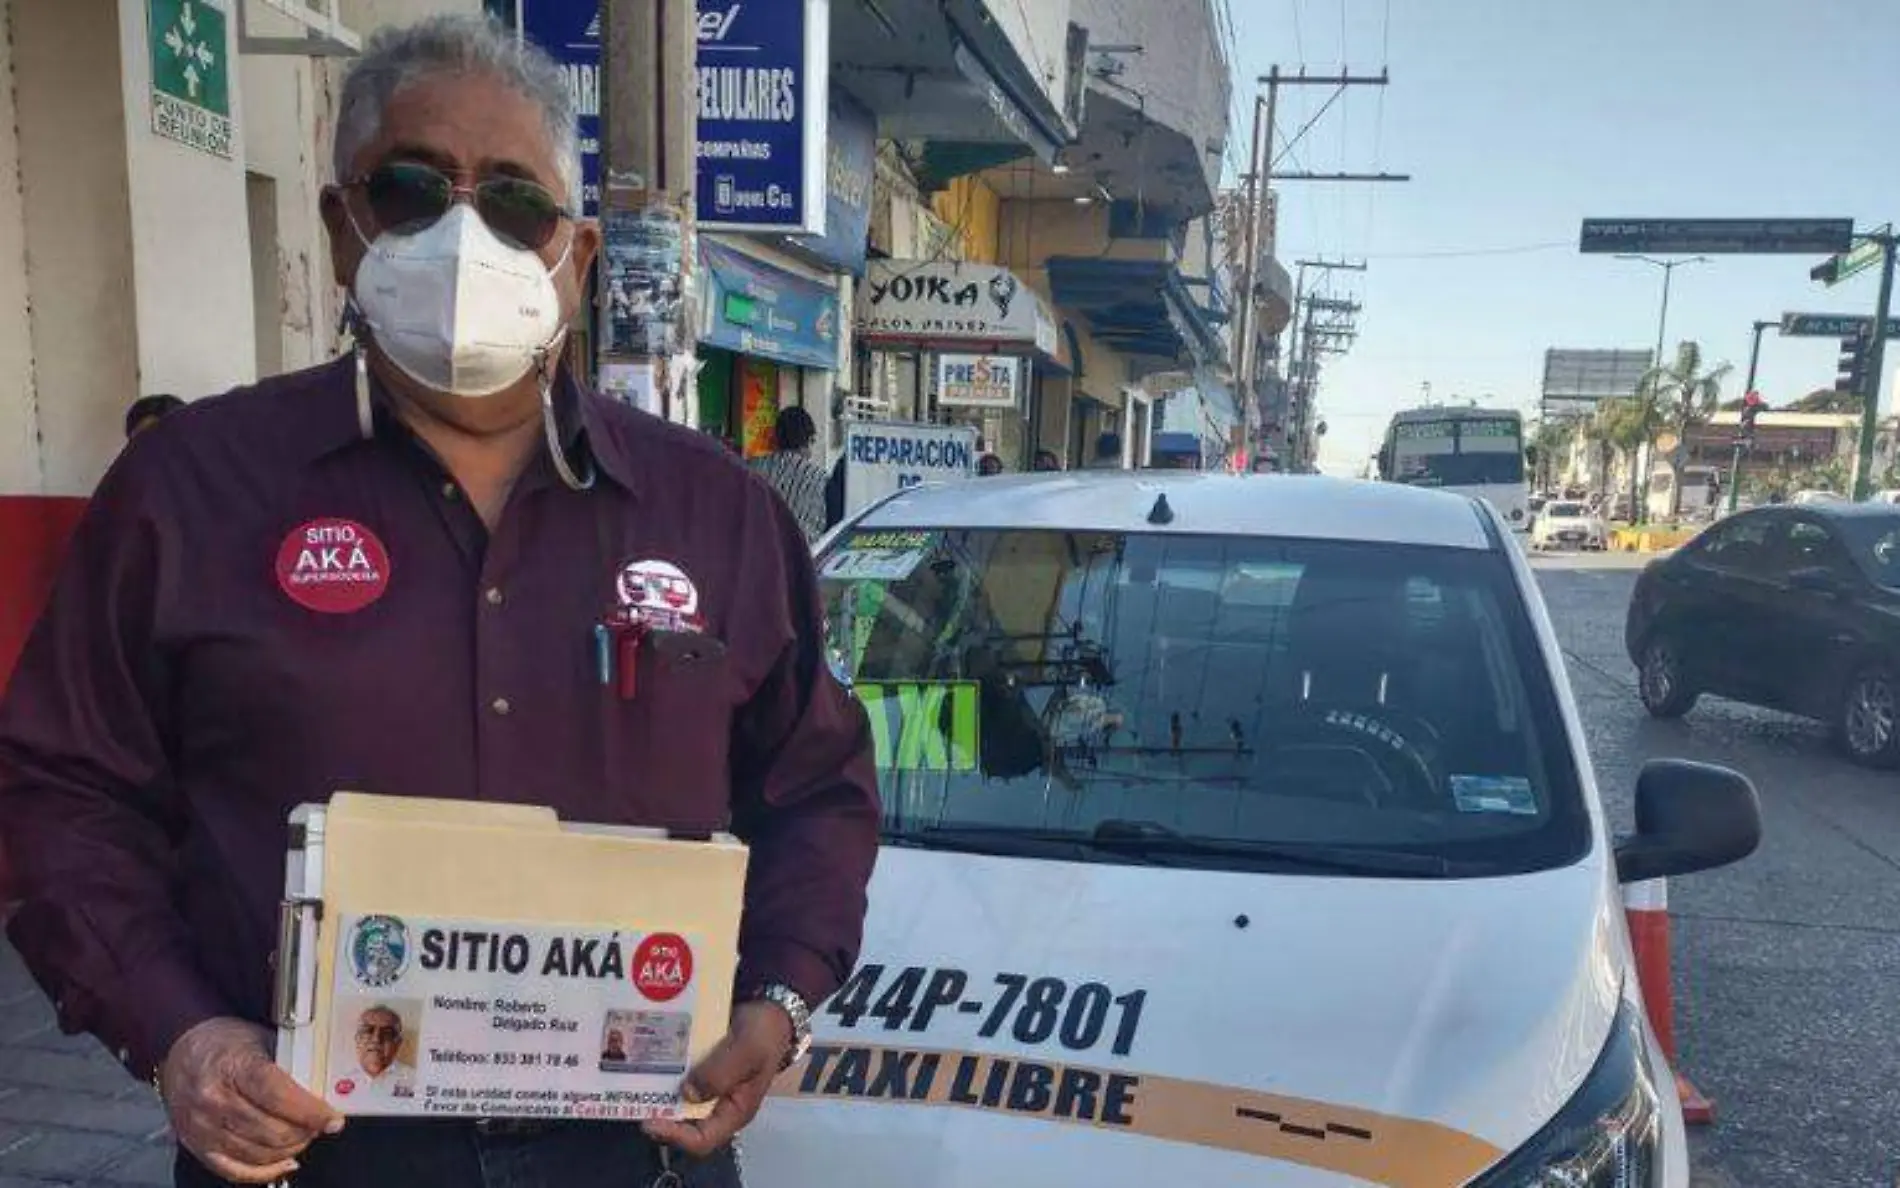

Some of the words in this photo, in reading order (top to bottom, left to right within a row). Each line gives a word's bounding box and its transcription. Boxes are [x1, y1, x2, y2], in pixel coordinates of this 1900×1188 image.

[307, 525, 355, 544] SITIO
[297, 538, 371, 571] AKÁ
[419, 929, 529, 975] SITIO
[541, 933, 625, 980] AKÁ
[494, 998, 546, 1013] Roberto
[825, 963, 1147, 1057] 44P-7801
[493, 1016, 546, 1031] Delgado
[798, 1045, 942, 1100] TAXI
[949, 1055, 1140, 1125] LIBRE
